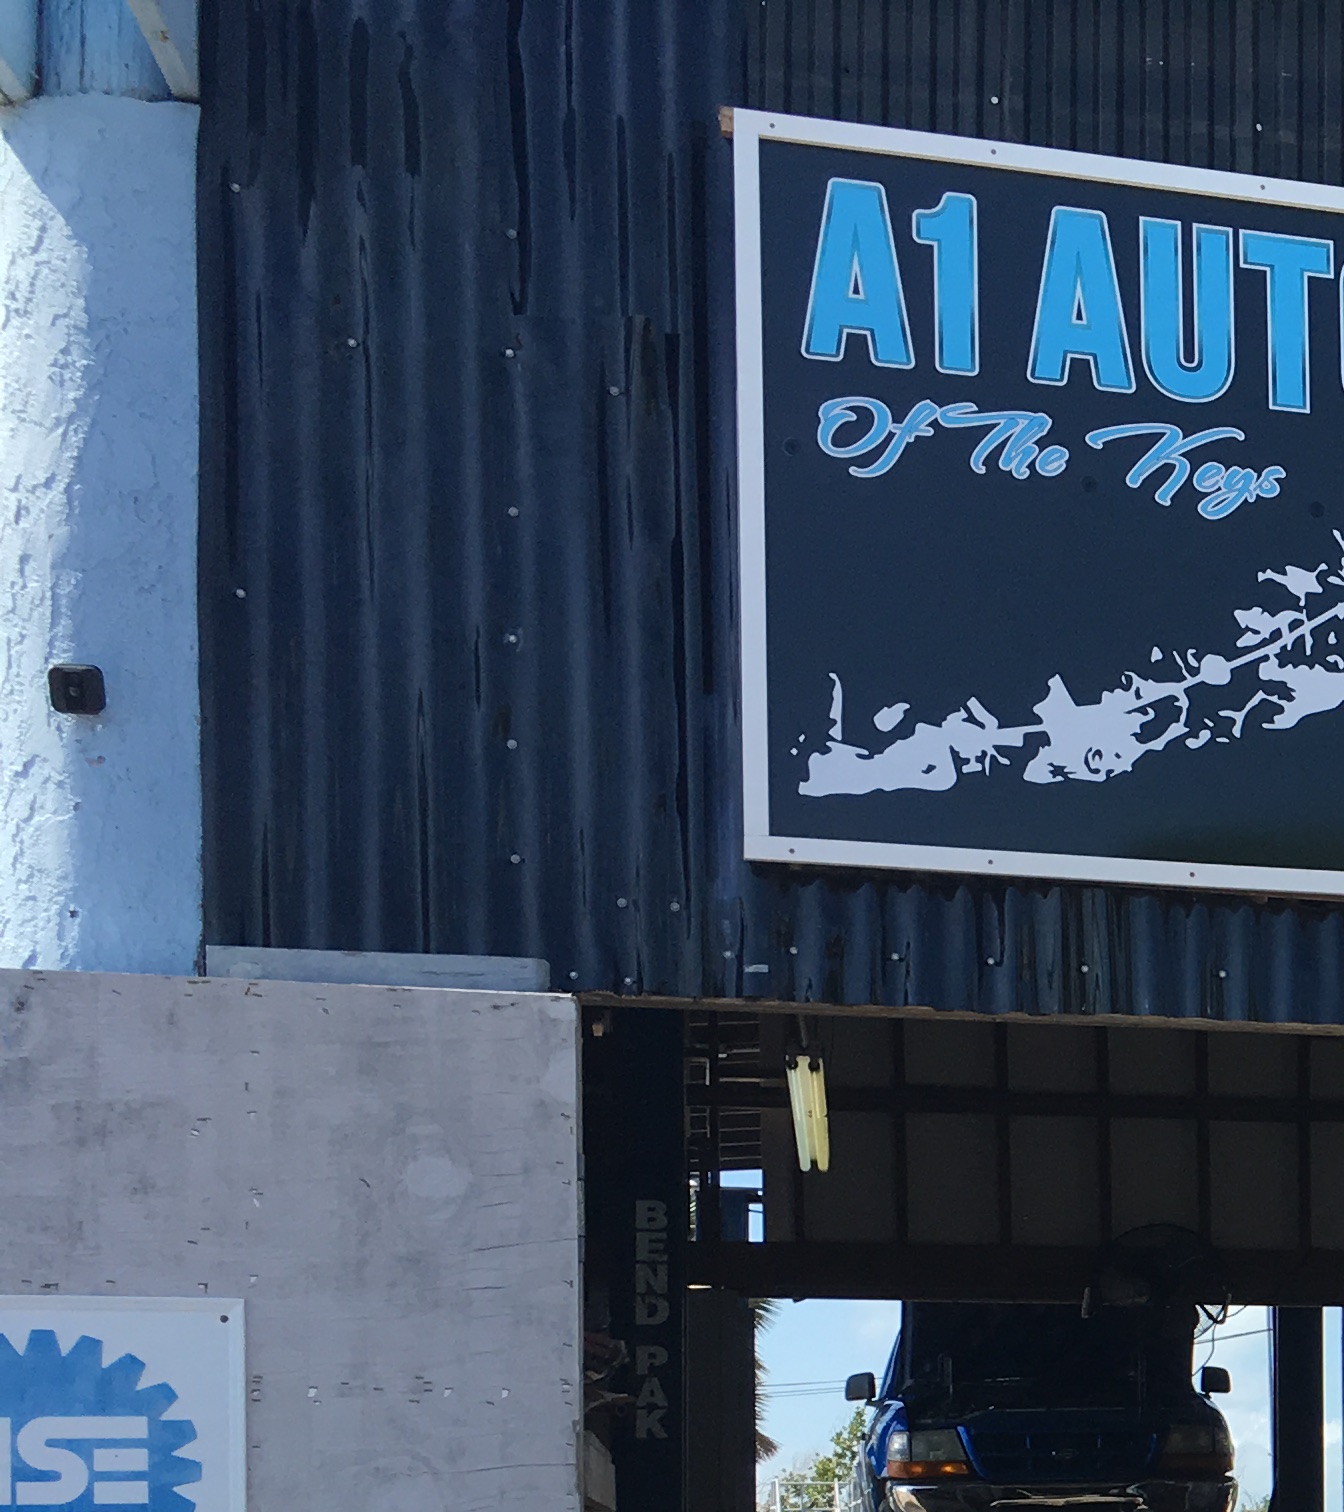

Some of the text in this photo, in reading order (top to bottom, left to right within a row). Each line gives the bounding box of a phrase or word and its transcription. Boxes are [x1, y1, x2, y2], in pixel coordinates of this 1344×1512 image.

[801, 177, 979, 376] A1
[817, 396, 1286, 520] Of The Keys
[635, 1200, 670, 1440] BEND PAK
[0, 1415, 149, 1506] SE
